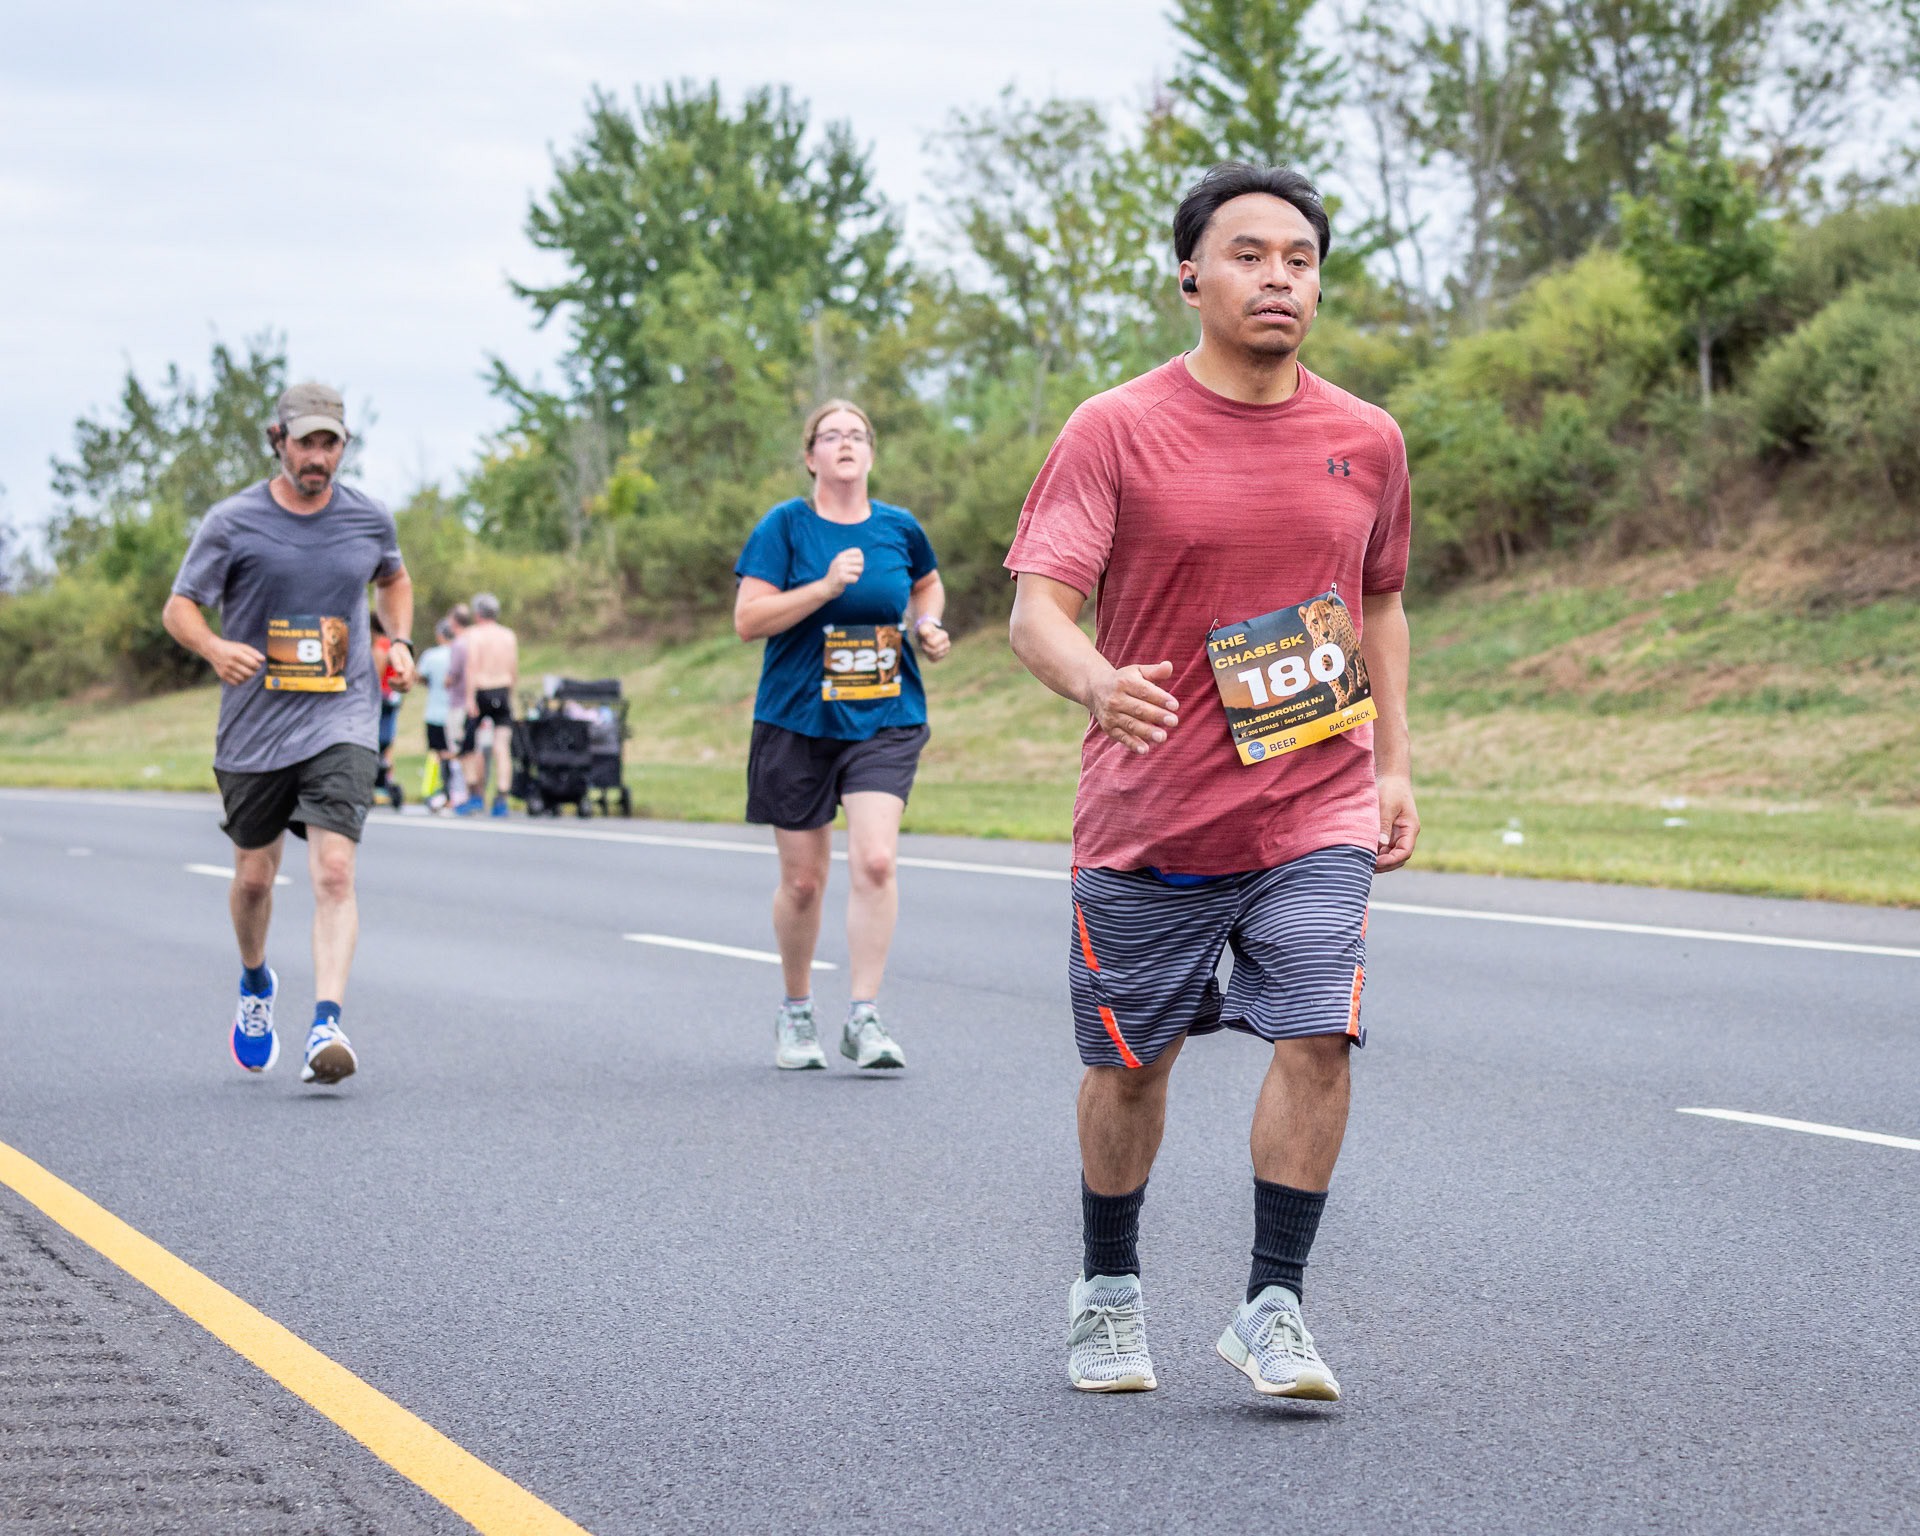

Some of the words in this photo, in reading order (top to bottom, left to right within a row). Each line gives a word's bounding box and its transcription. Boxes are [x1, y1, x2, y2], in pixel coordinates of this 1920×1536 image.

[296, 638, 322, 664] 8
[1209, 633, 1247, 653] THE
[1214, 642, 1278, 670] CHASE
[1279, 632, 1305, 651] 5K
[831, 648, 897, 672] 323
[1237, 643, 1346, 706] 180
[1311, 694, 1325, 705] NJ
[1259, 722, 1280, 733] BYPASS
[1283, 716, 1297, 725] Sept
[1329, 720, 1346, 732] BAG
[1346, 710, 1371, 725] CHECK
[1269, 737, 1297, 752] BEER
